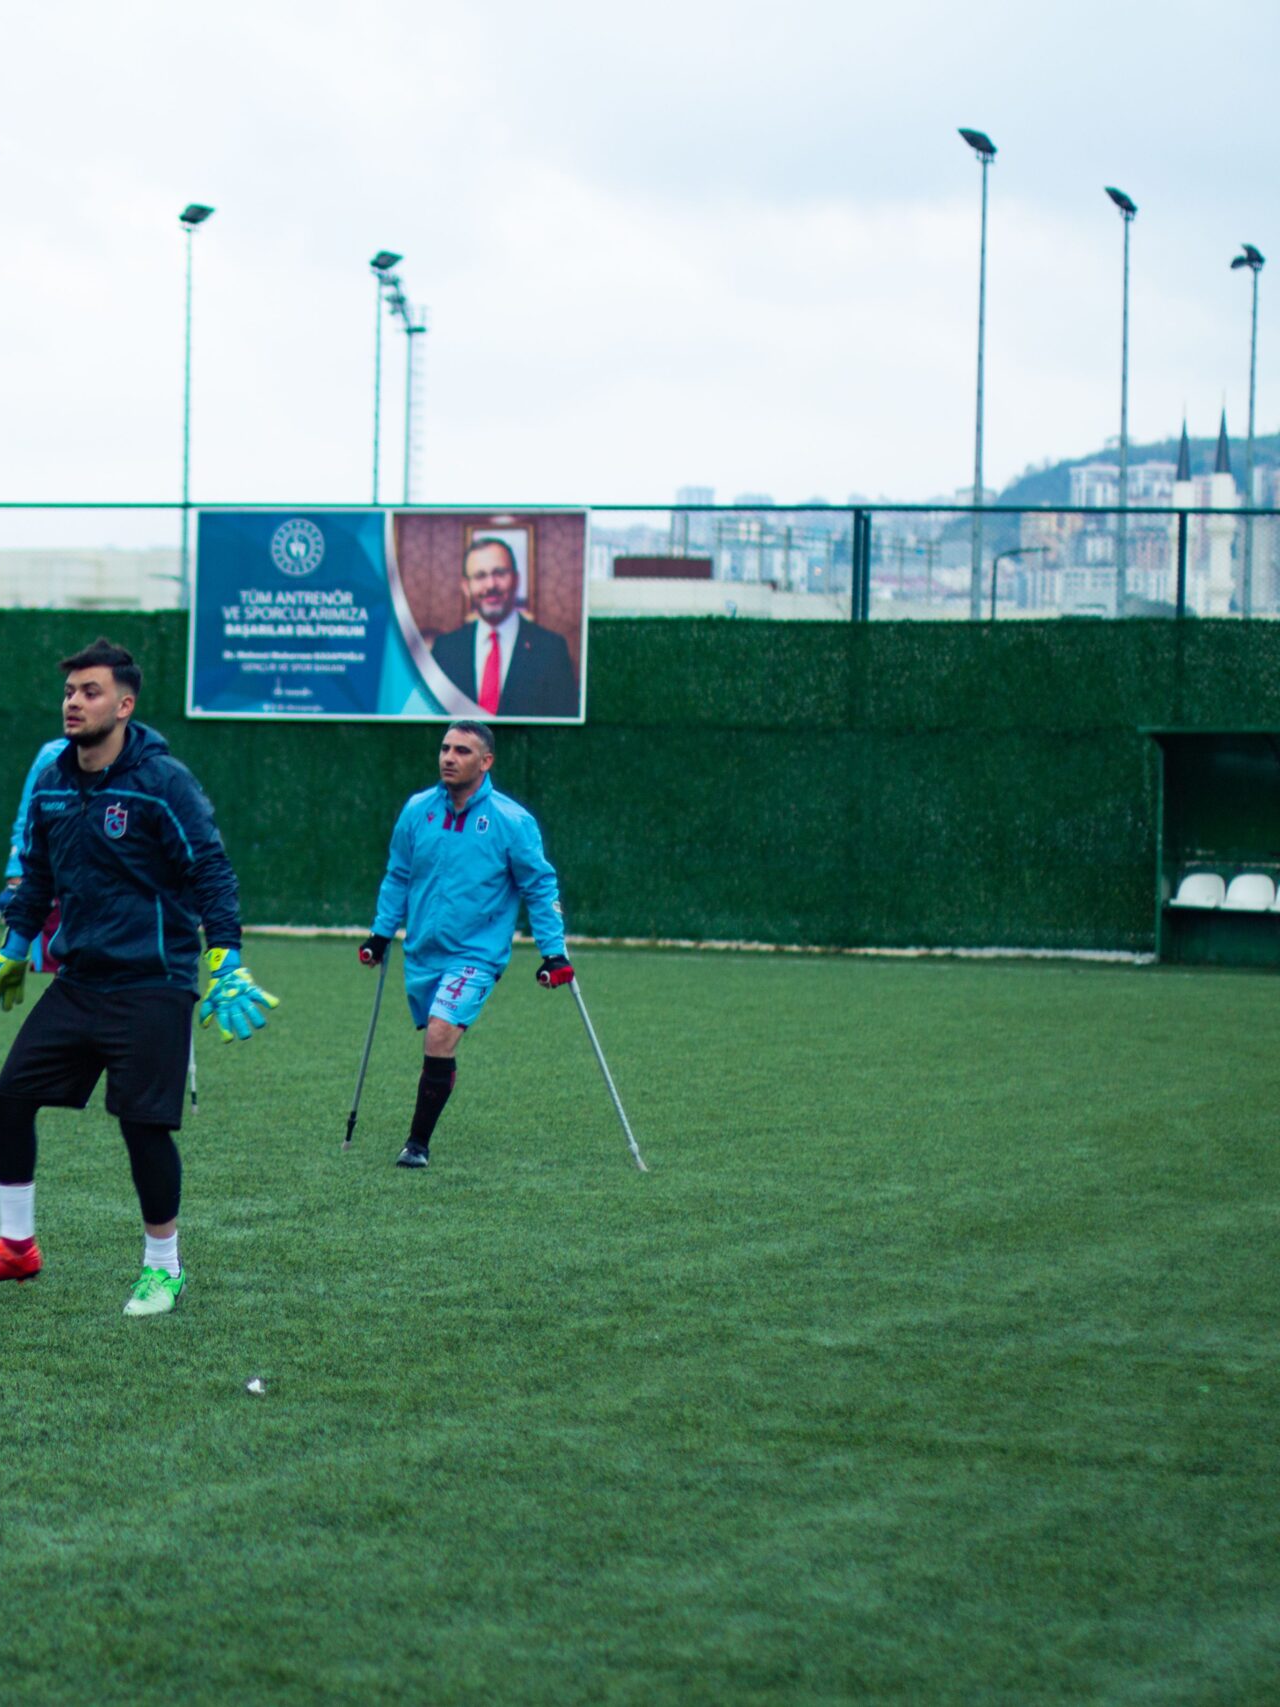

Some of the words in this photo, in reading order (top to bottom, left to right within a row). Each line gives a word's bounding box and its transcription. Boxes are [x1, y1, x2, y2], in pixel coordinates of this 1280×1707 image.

[240, 588, 272, 605] TÜM
[275, 588, 353, 605] ANTRENÖR
[222, 606, 240, 620] VE
[244, 607, 368, 621] SPORCULARIMIZA
[445, 976, 468, 1000] 4
